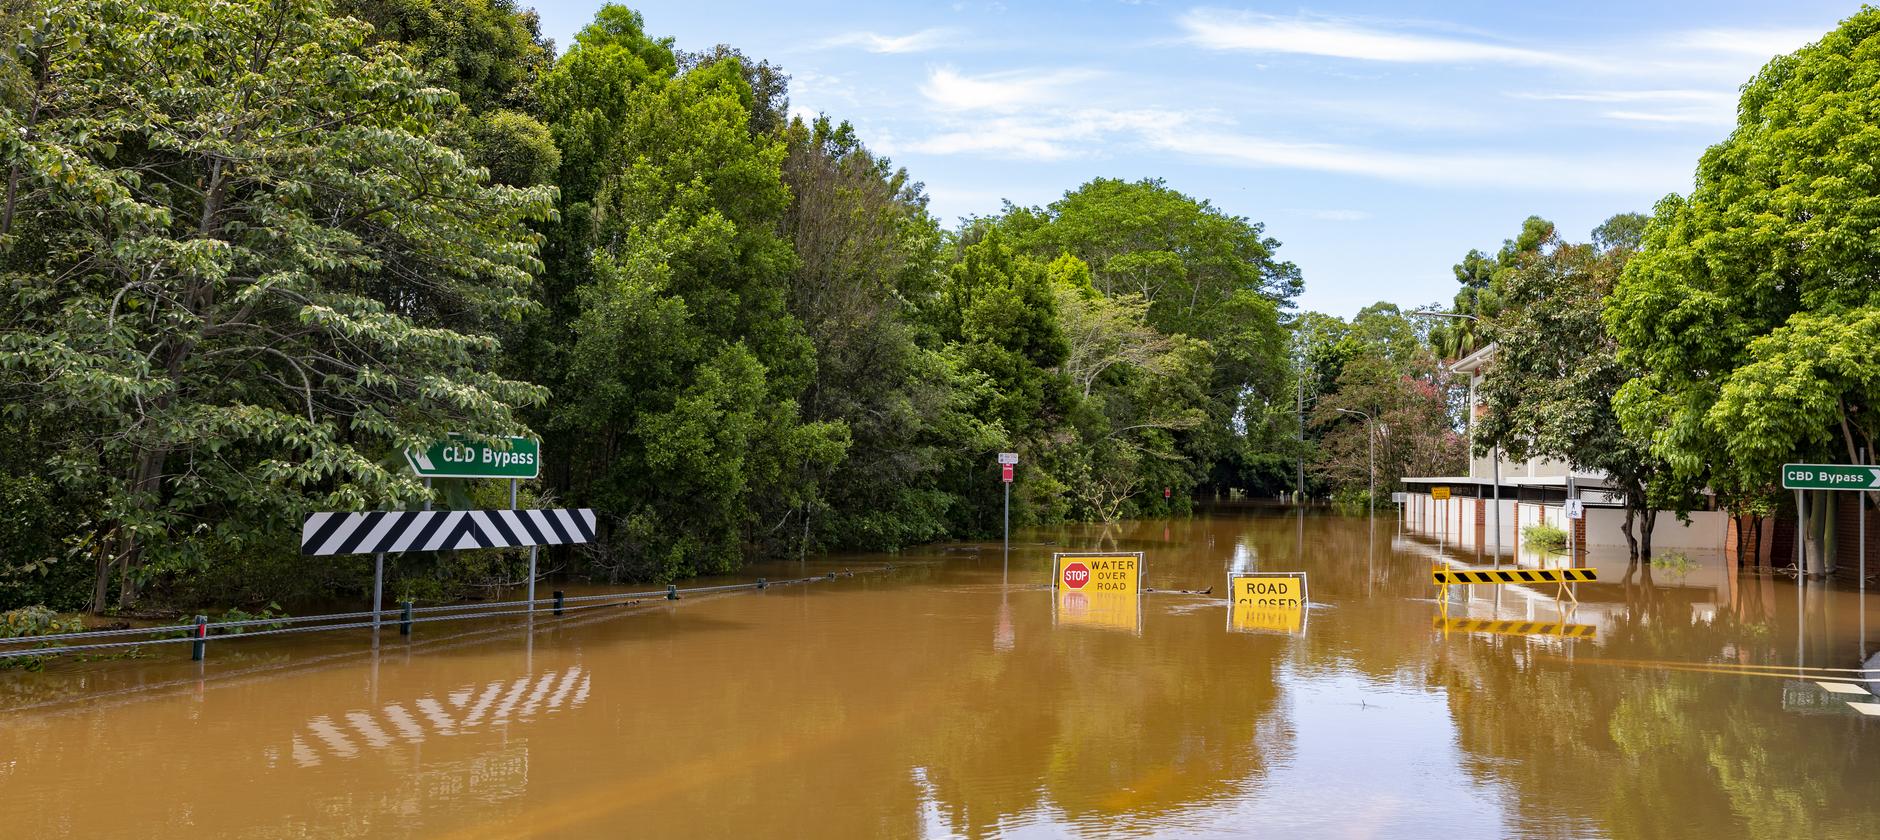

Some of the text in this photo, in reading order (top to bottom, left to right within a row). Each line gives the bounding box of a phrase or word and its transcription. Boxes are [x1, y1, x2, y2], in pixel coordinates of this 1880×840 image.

[482, 447, 534, 467] Bypass
[1787, 471, 1864, 484] CBD Bypass
[1091, 561, 1134, 570] WATER
[1065, 570, 1088, 581] STOP
[1097, 572, 1126, 580] OVER
[1097, 582, 1127, 590] ROAD
[1246, 583, 1288, 595] ROAD
